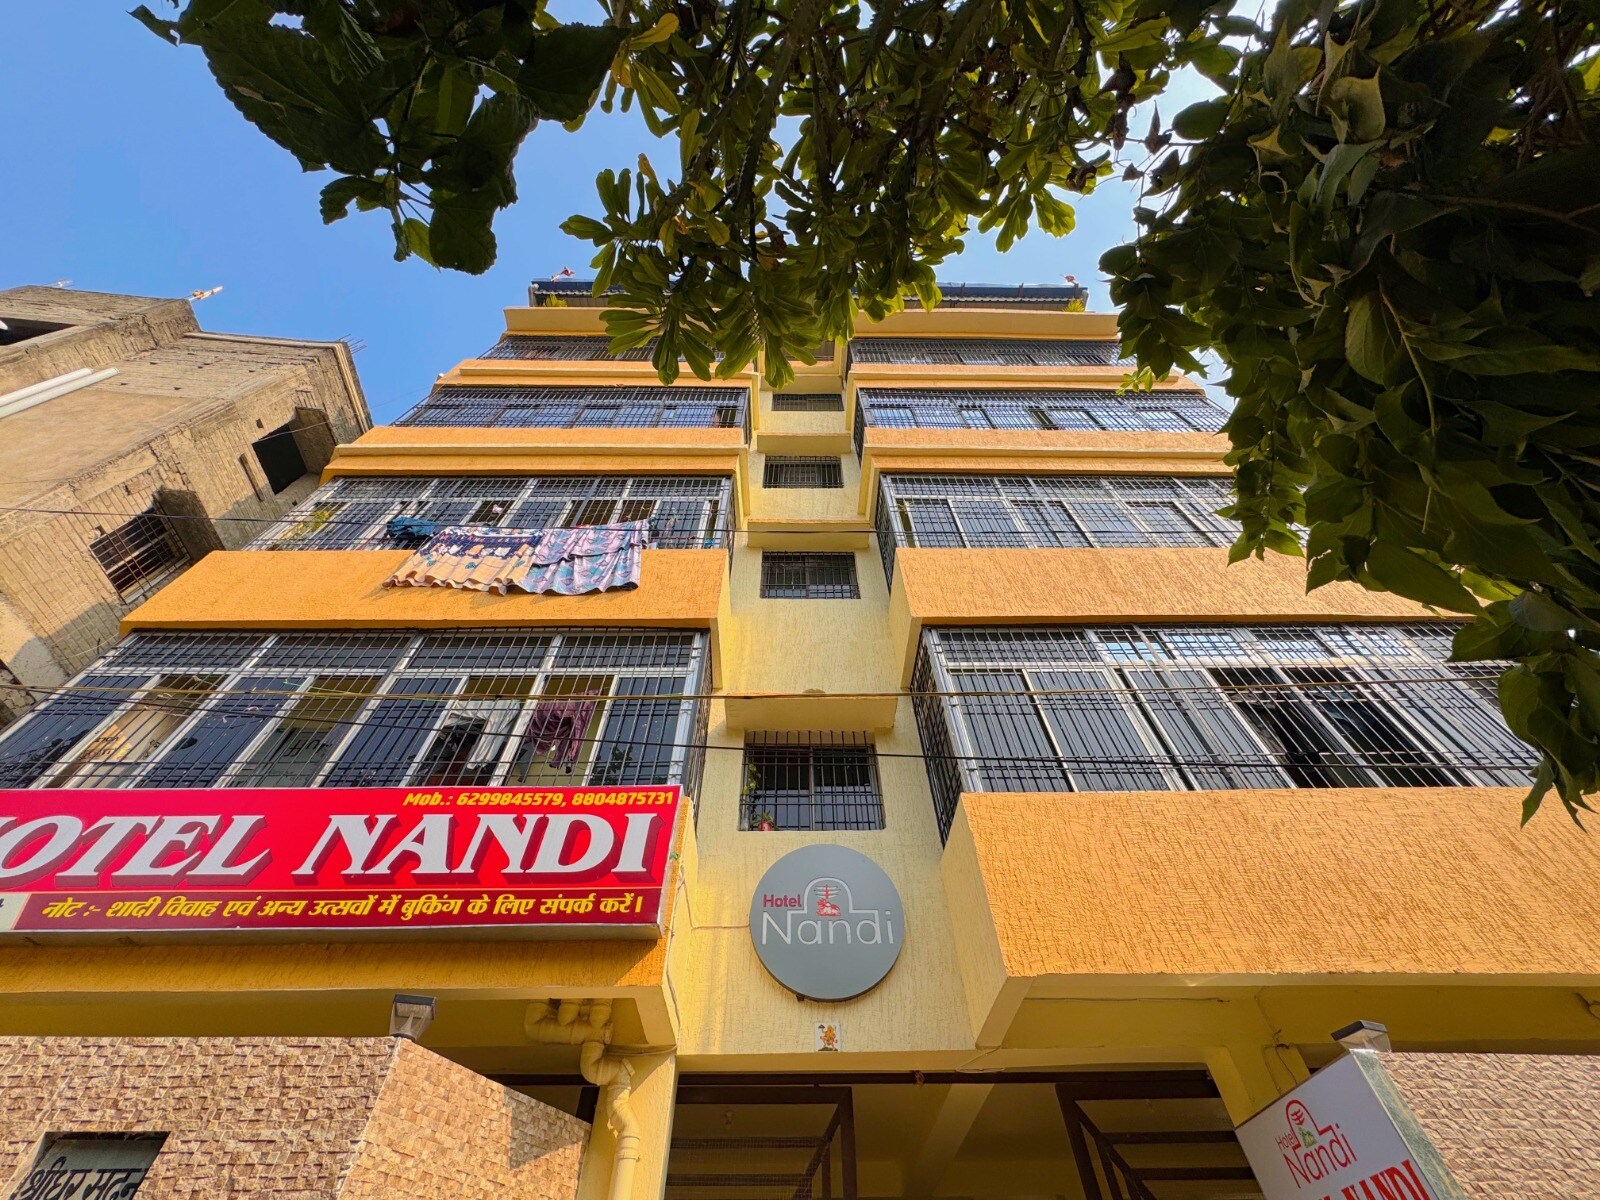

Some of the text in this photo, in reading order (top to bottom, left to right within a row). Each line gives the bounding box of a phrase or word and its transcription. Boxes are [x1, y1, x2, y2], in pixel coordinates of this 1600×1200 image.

[402, 790, 673, 808] Mob.: 6299845579, 8804875731
[0, 813, 660, 882] OTEL NANDI
[41, 897, 87, 918] नोट
[106, 895, 161, 918] शादी
[166, 895, 220, 918] विवाह
[223, 894, 260, 918] एवं
[259, 899, 308, 917] अन्य
[309, 894, 378, 917] उत्सवों
[378, 893, 400, 915] में
[401, 893, 464, 920] बुकिंग
[467, 893, 490, 915] के
[493, 893, 535, 915] लिए
[539, 892, 594, 915] संपर्क
[763, 894, 802, 908] Hotel
[761, 910, 895, 945] Nandi
[1275, 1130, 1298, 1151] Hotel
[1283, 1122, 1358, 1189] Nandi
